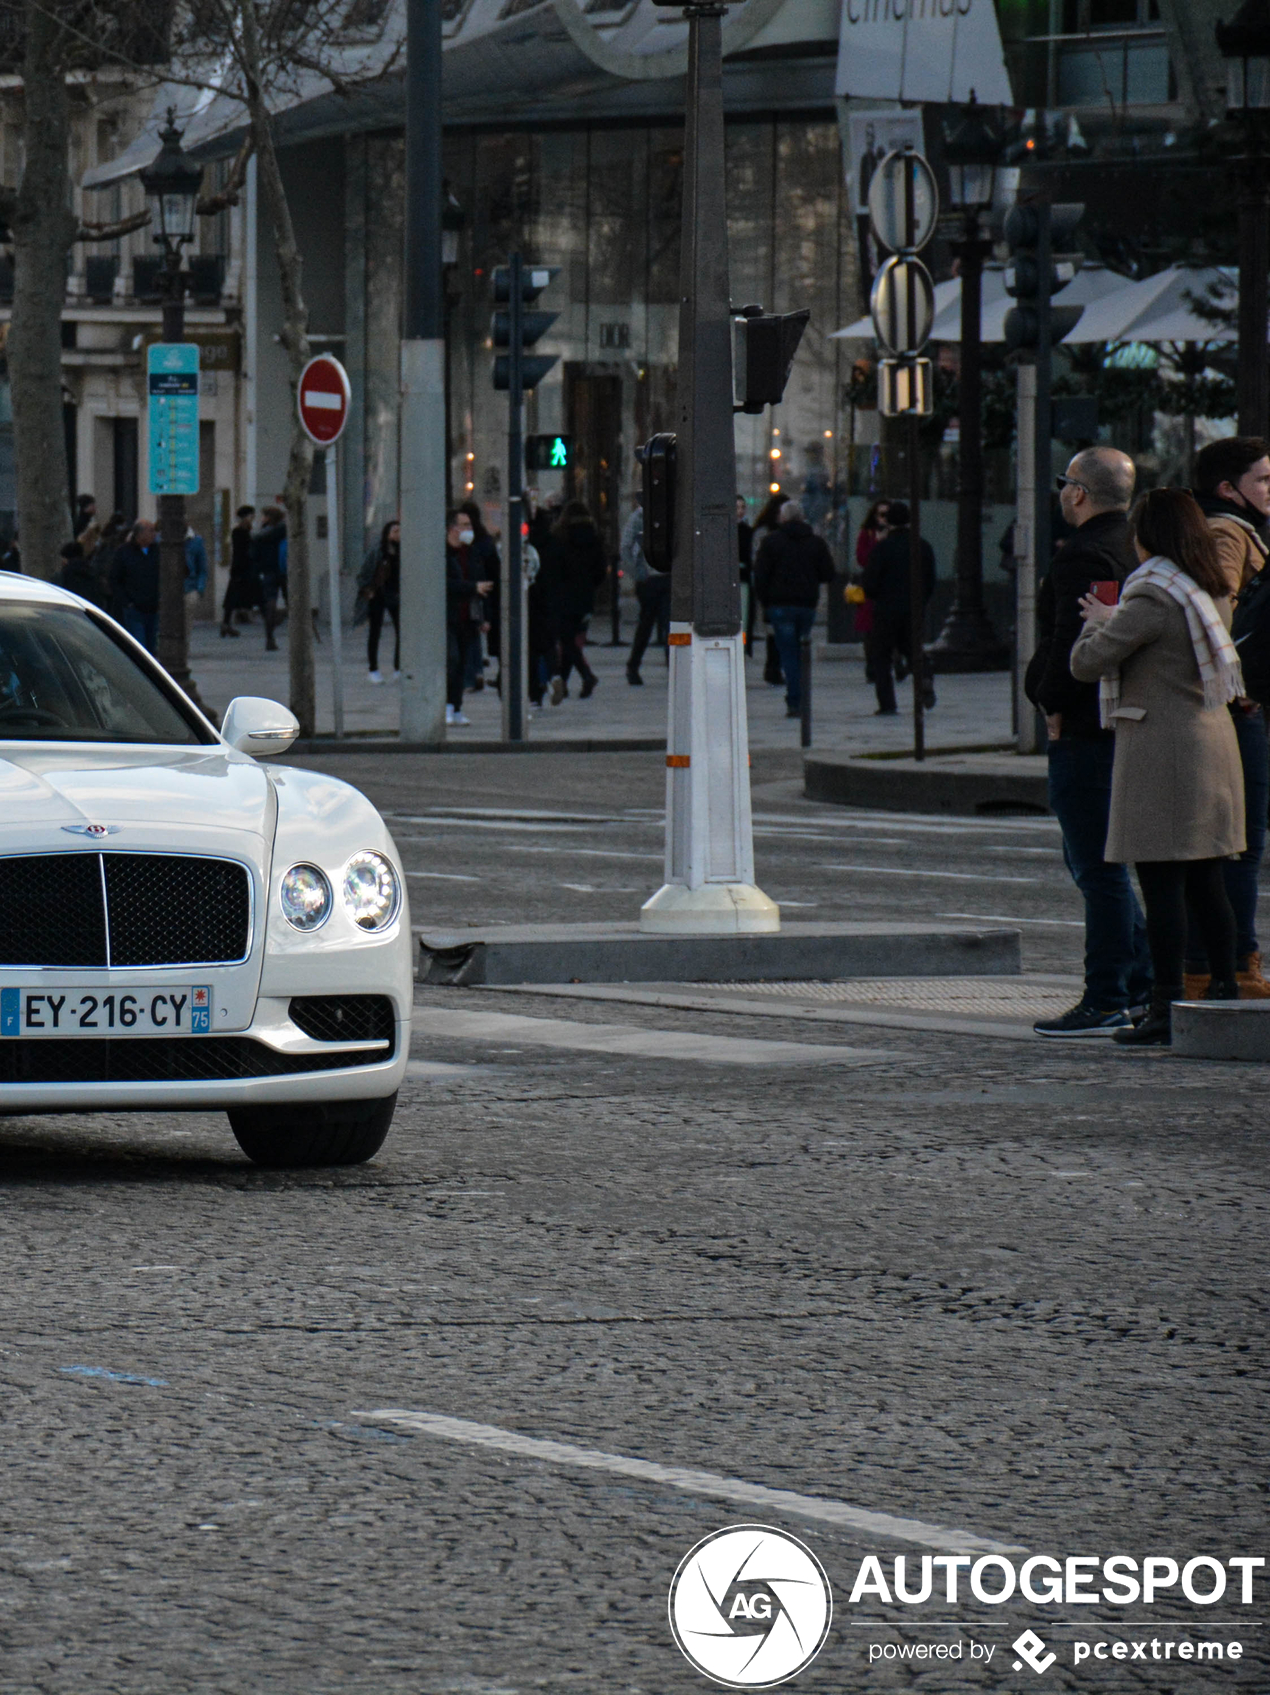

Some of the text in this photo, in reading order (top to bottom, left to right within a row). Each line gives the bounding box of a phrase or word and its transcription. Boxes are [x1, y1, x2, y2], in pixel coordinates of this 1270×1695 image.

[26, 994, 187, 1028] EY-216-CY
[192, 1011, 208, 1028] 75
[7, 1016, 14, 1027] F
